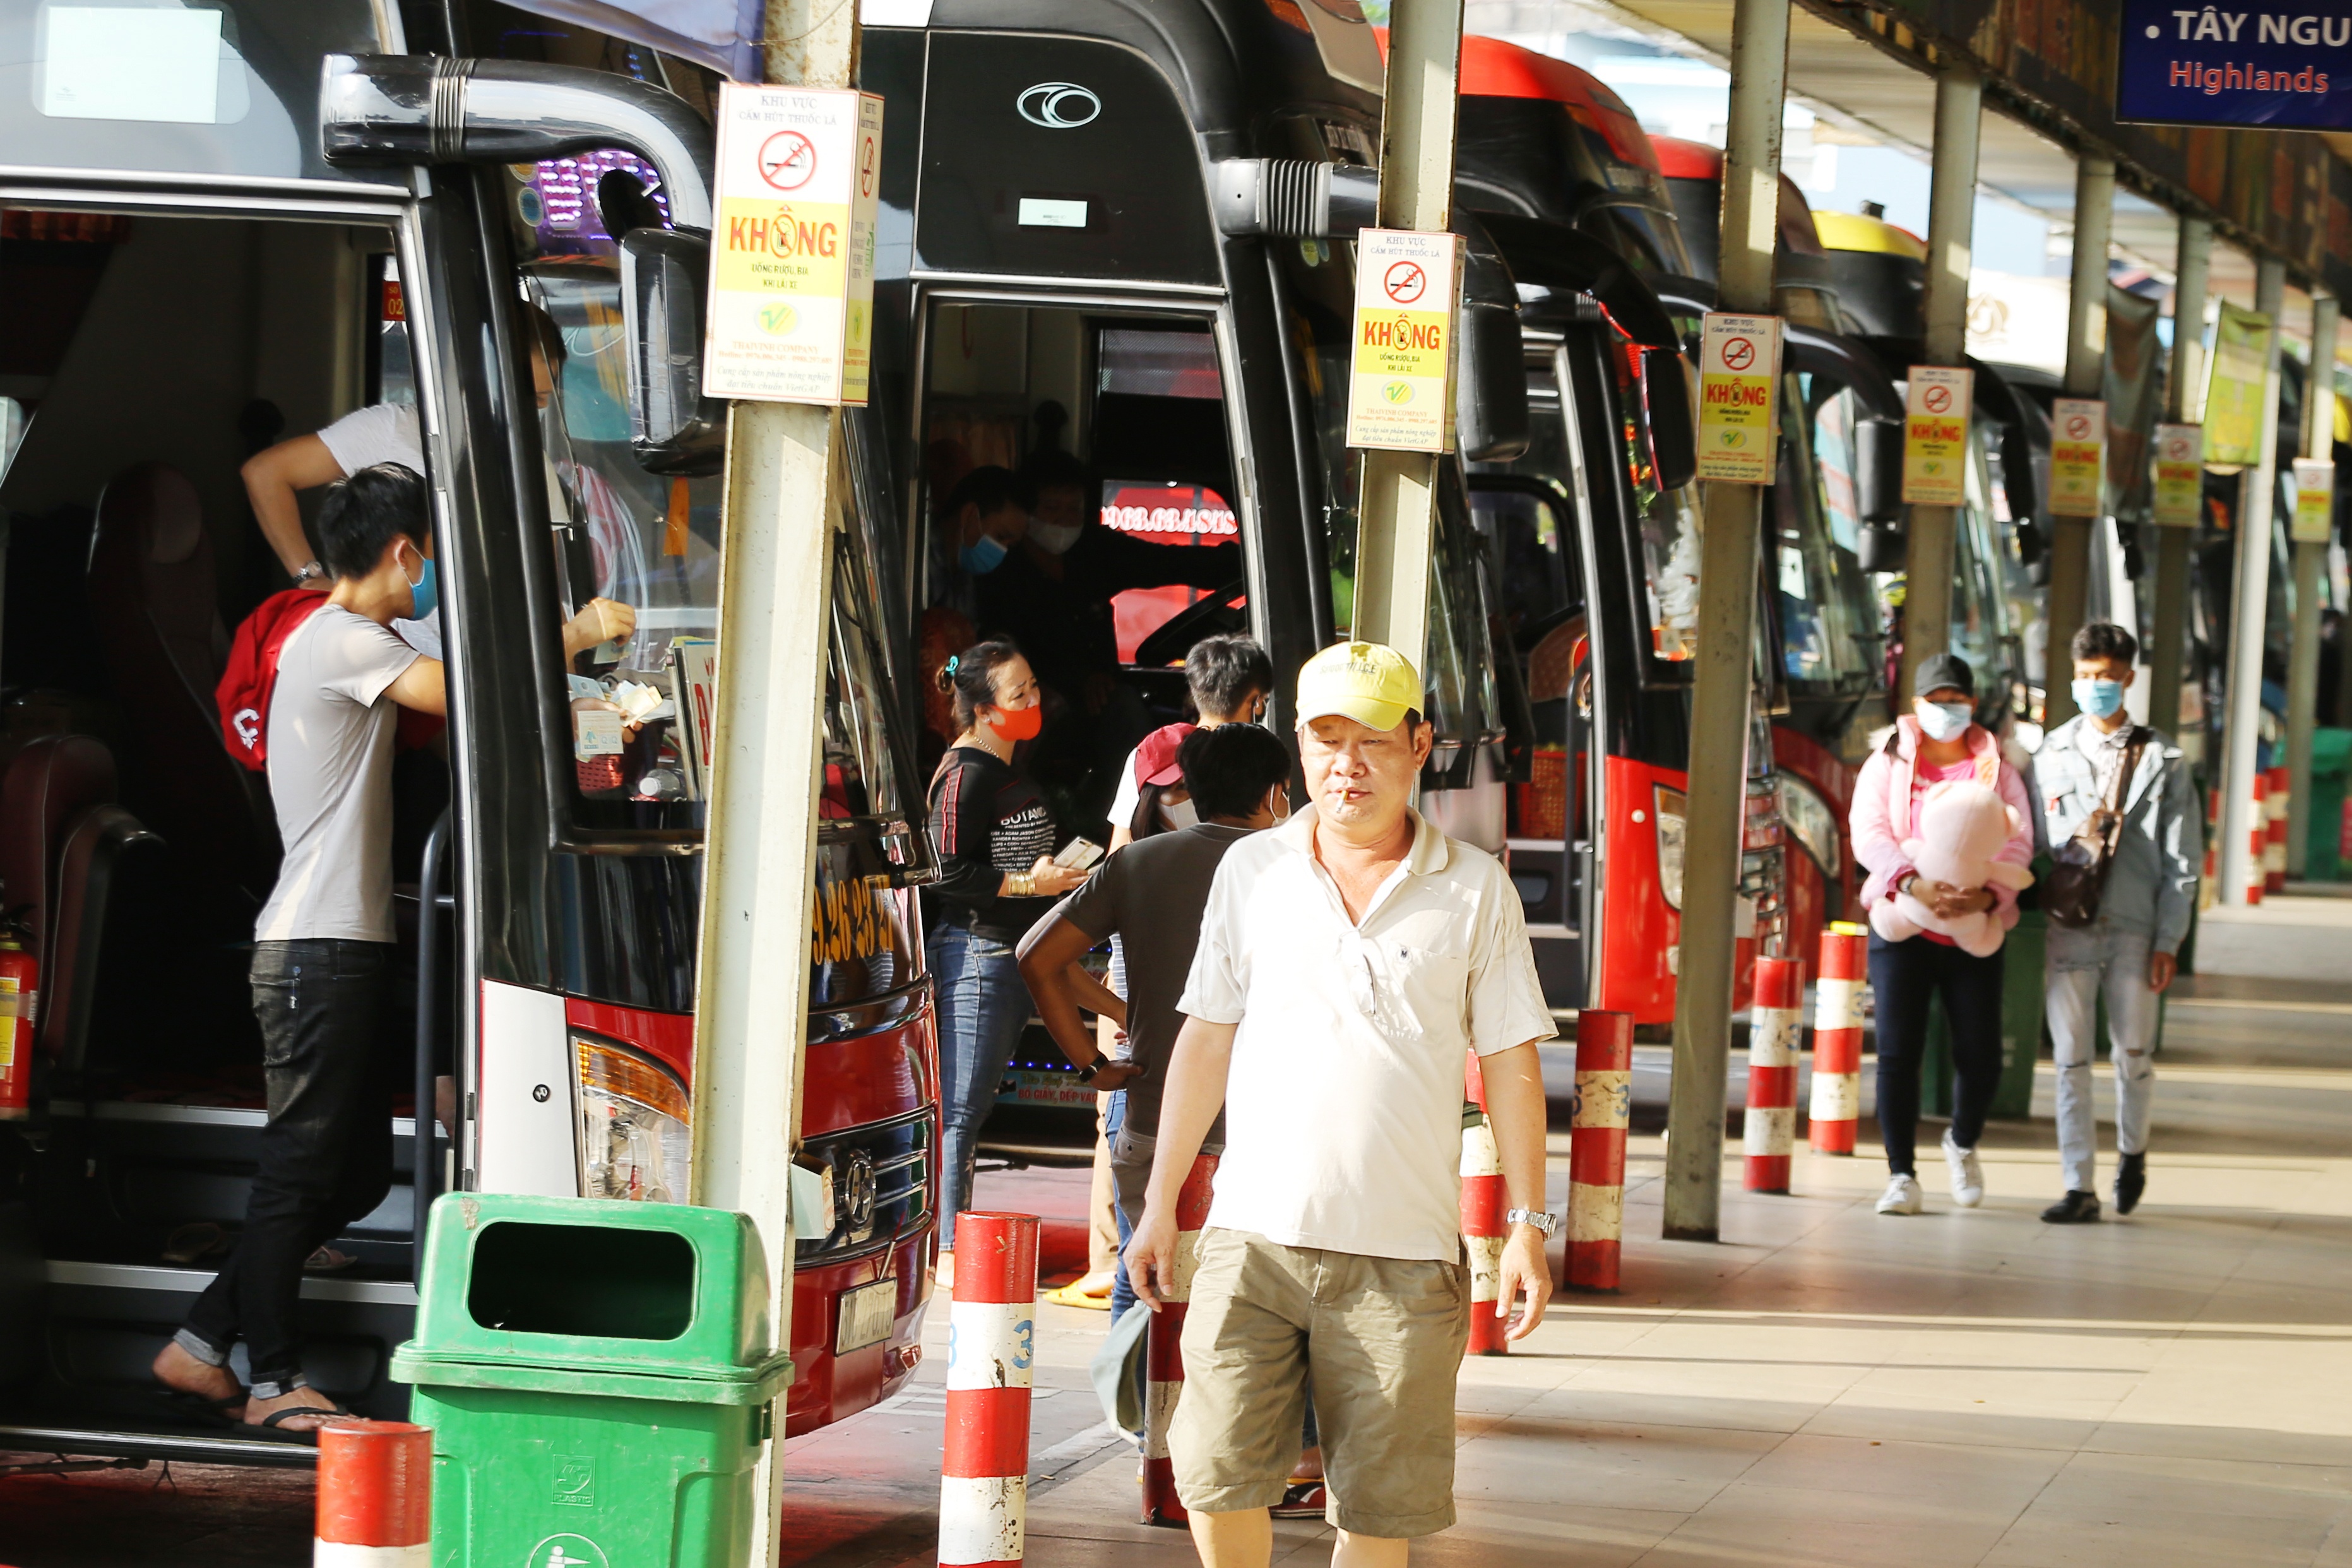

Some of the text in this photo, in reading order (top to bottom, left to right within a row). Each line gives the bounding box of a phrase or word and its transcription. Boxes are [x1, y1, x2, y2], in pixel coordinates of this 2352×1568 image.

[2172, 5, 2351, 47] TÂY NGU
[2170, 61, 2329, 95] Highlands
[761, 95, 817, 110] KHU VỰC
[729, 204, 838, 259] KHÔNG
[1386, 236, 1405, 245] KHU
[789, 281, 798, 290] XE
[1363, 312, 1441, 351] KHÔNG
[776, 344, 819, 355] COMPANY
[716, 365, 736, 377] Cung
[1706, 377, 1766, 407] KHÔNG
[1397, 410, 1428, 419] COMPANY
[1615, 1084, 1630, 1118] 3
[1011, 1319, 1034, 1369] 3
[554, 1494, 591, 1504] PLASTIC
